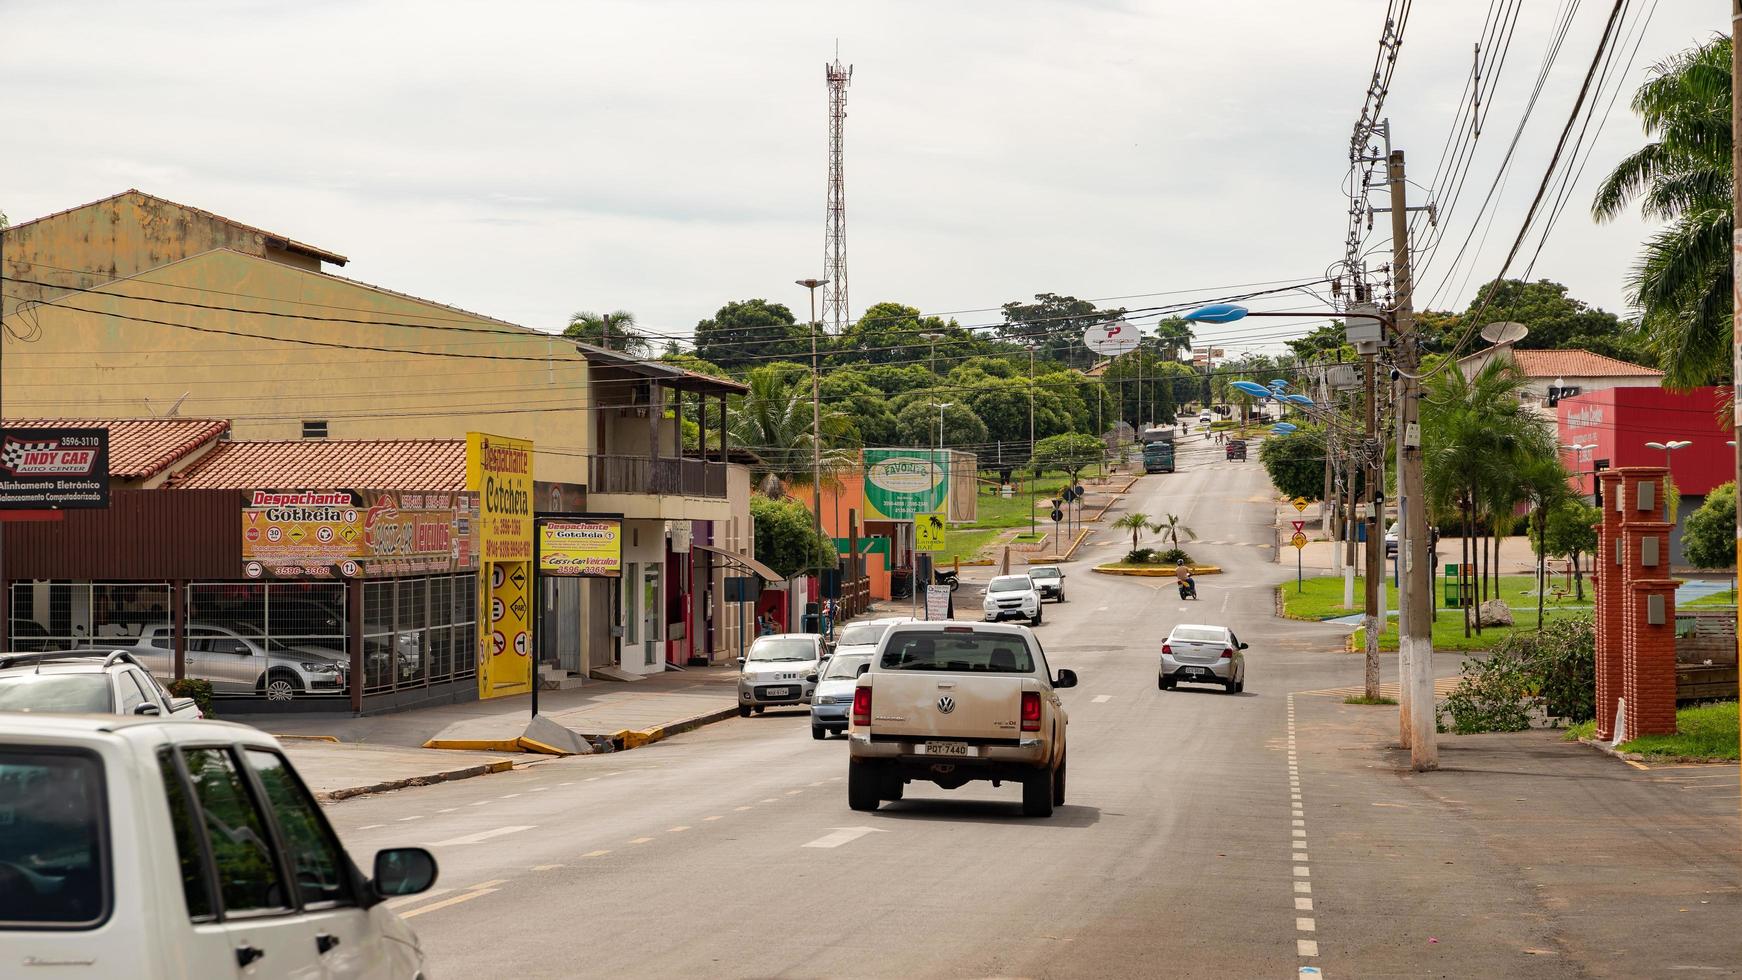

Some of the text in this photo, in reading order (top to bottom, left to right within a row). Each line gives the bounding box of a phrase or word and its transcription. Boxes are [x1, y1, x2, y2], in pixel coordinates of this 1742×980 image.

[61, 437, 99, 446] 3596-3110
[23, 452, 89, 465] INDY CAR
[57, 480, 100, 489] Eletrônico
[0, 492, 101, 502] alanceamento Computadorizado
[251, 491, 351, 507] Despachante
[547, 523, 609, 531] Despachante
